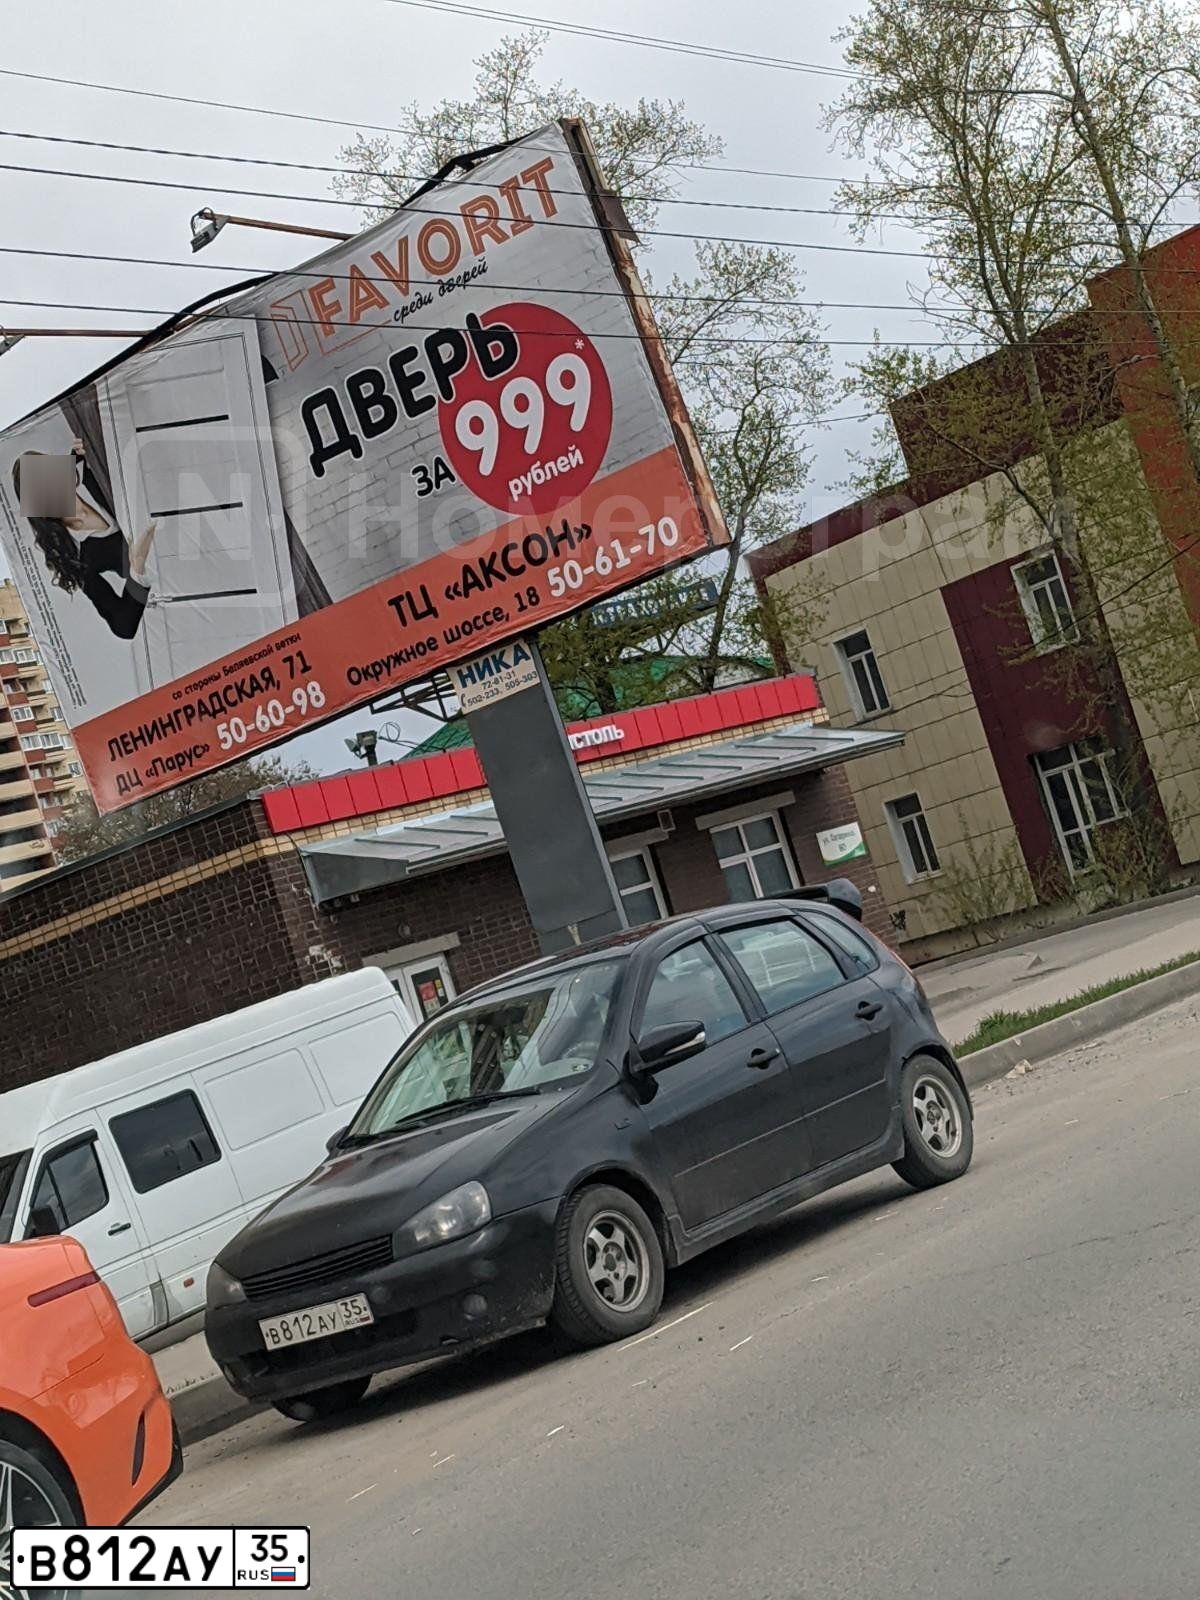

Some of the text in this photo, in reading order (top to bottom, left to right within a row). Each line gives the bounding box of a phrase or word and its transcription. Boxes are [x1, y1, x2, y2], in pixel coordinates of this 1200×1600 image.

[308, 156, 558, 337] FAVORIT
[393, 256, 488, 323] среди дверей
[301, 311, 519, 479] ДВЕРЬ
[411, 457, 455, 497] ЗА
[508, 445, 584, 502] рублей
[346, 635, 439, 686] Окружное
[442, 605, 511, 645] шоссе,
[513, 586, 541, 613] 18
[546, 515, 679, 598] 50-61-70
[388, 518, 593, 627] ТЦ «АКСОН»
[107, 650, 312, 762] ЛЕНИНГРАДСКАЯ, 71
[456, 642, 531, 689] НИКА
[115, 680, 327, 796] ДЦ «Парус» 50-60-98
[340, 1298, 363, 1319] 35
